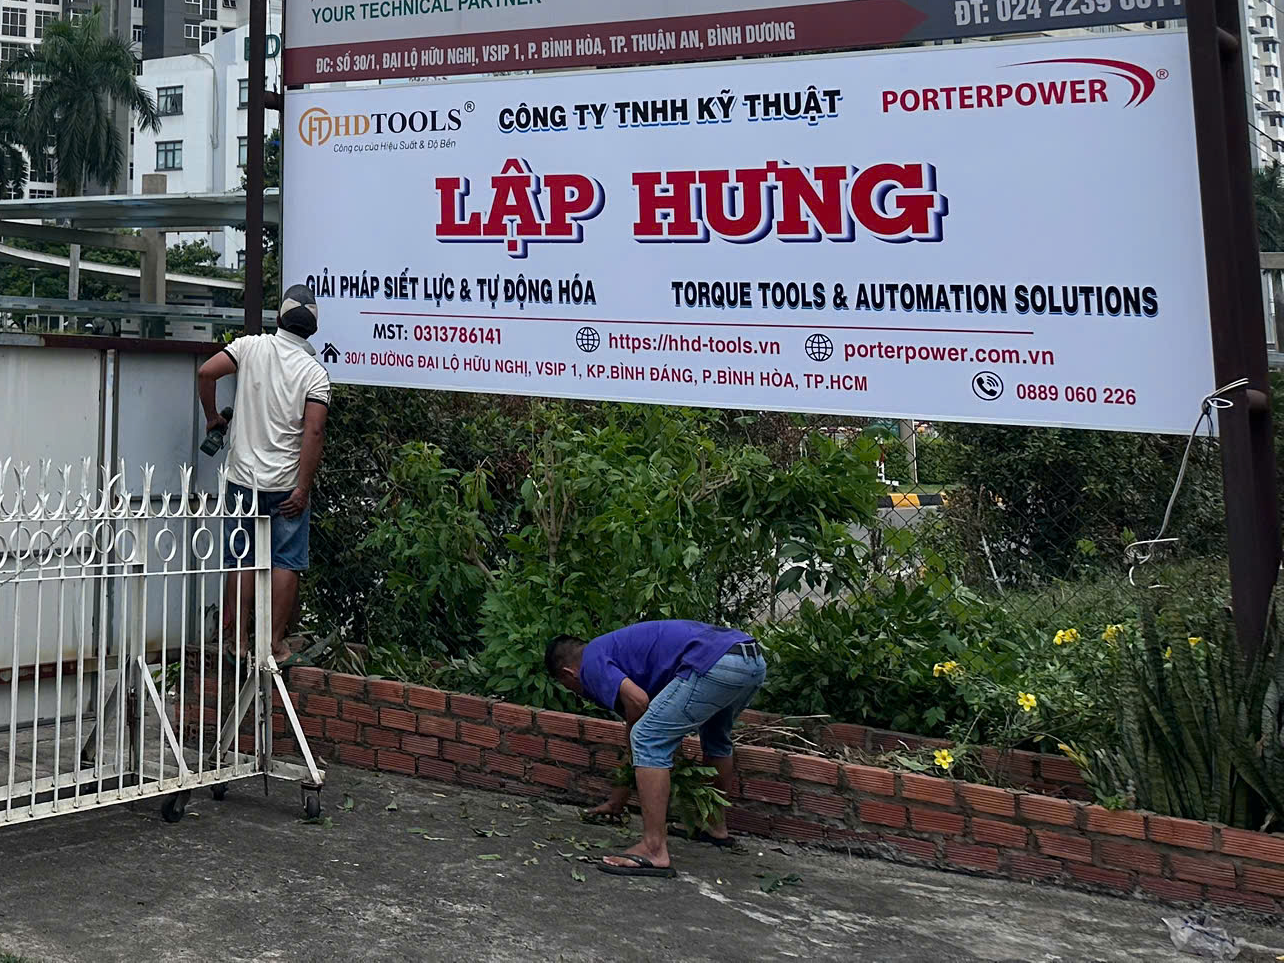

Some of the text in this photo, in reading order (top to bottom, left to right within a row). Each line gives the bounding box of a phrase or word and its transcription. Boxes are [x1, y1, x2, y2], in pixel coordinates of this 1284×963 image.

[311, 5, 355, 24] YOUR
[316, 21, 796, 74] ĐC: SỐ 30/1, ĐẠI LỘ HỮU NGHỊ, VSIP 1, P. BÌNH HÒA, TP. THUẬN AN, BÌNH DƯƠNG
[499, 85, 843, 132] CÔNG TY TNHH KỸ THUẬT
[882, 79, 1109, 113] PORTERPOWER
[333, 138, 456, 154] Công cụ của Hiệu Suất & Độ Bền
[435, 158, 948, 257] LẬP HƯNG
[306, 267, 596, 310] GIẢI PHÁP SIẾT LỰC & TỰ ĐỘNG HÓA
[671, 281, 1159, 317] TORQUE TOOLS & AUTOMATION SOLUTIONS
[373, 323, 502, 345] MST: 0313786141
[609, 332, 781, 355] https://hhd-tools.vn
[345, 350, 868, 391] 30/1 ĐƯỜNG ĐẠI LỘ HỮU NGHỊ, VSIP 1, KP.BÌNH ĐÁNG, P.BÌNH HÒA, TP.HCM
[844, 341, 1054, 366] porterpower.com.vn
[1016, 383, 1136, 406] 0889 060 226
